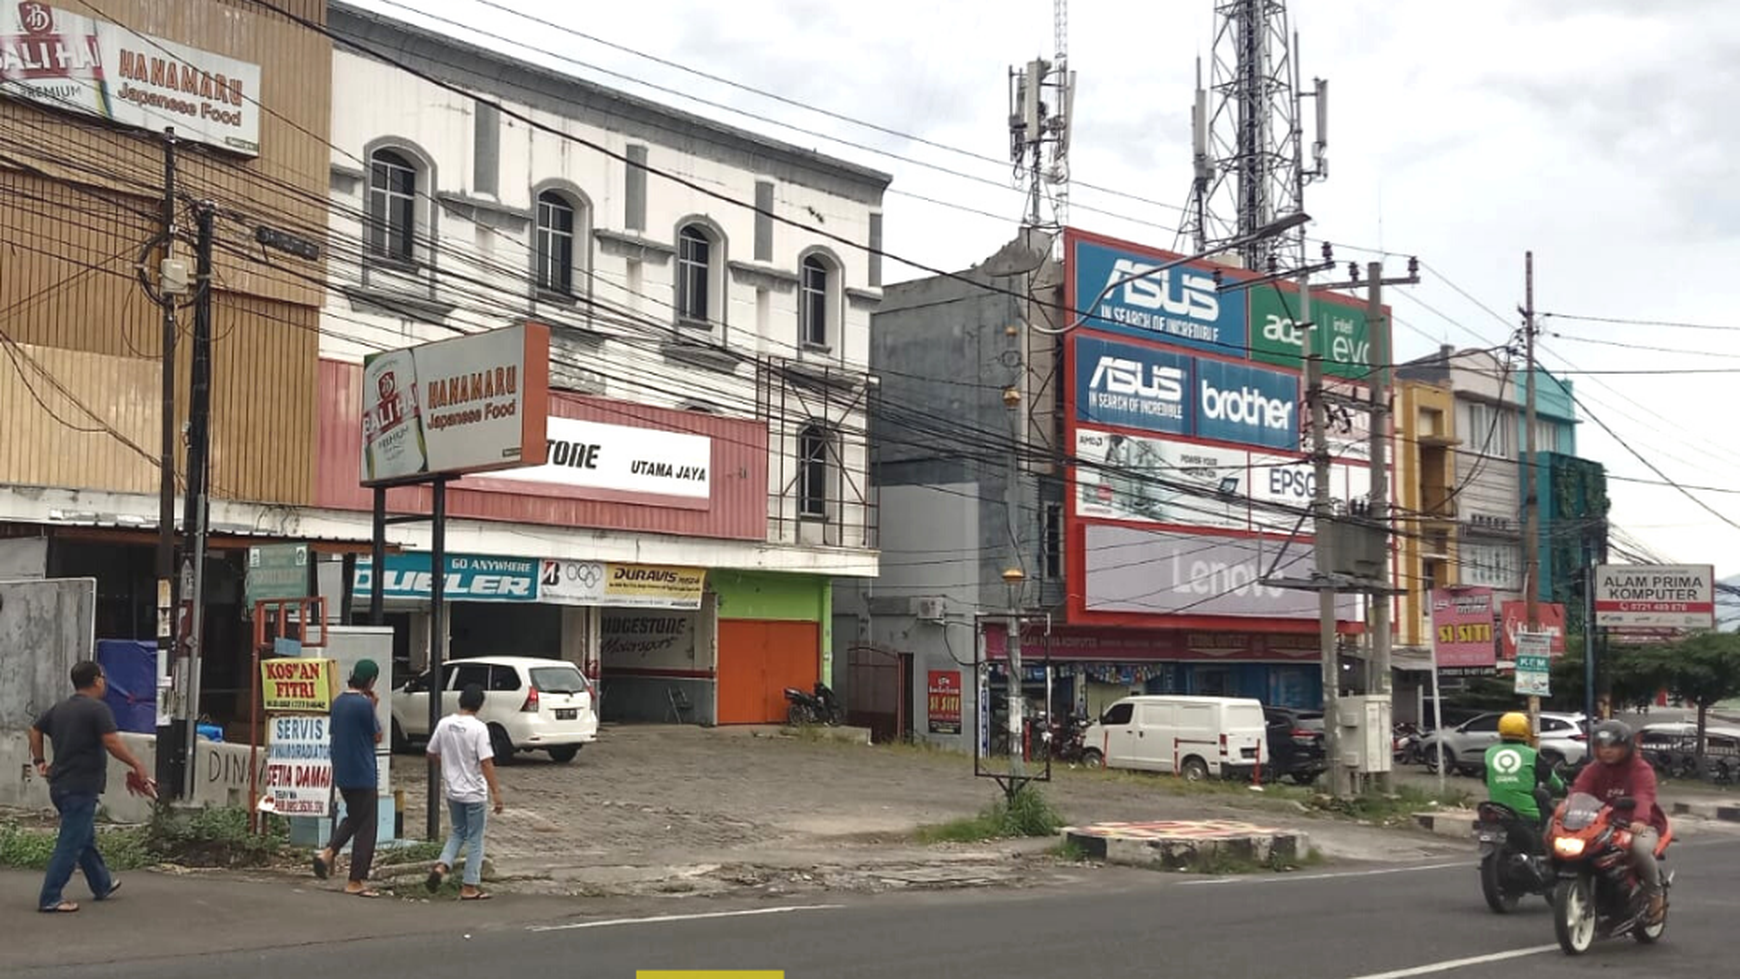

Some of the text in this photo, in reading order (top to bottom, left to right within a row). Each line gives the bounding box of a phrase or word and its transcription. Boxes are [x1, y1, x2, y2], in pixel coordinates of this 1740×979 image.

[0, 40, 51, 71] ALI
[118, 48, 242, 107] HANAMARU
[117, 82, 241, 127] Japanese Food
[1104, 257, 1219, 322] ASUS
[427, 364, 517, 410] HANAMARU
[1088, 355, 1184, 401] ASUS
[426, 399, 516, 432] Japanese Food
[1202, 379, 1293, 430] brother
[547, 438, 602, 470] TONE
[630, 459, 706, 482] UTAMA JAYA
[1269, 467, 1317, 498] EPSO
[452, 558, 532, 573] GO ANYWHERE
[614, 567, 679, 583] DURAVIS
[1604, 576, 1704, 589] ALAM PRIMA
[1609, 588, 1699, 601] KOMPUTER
[275, 681, 316, 698] FITRI
[276, 718, 323, 739] SERVIS
